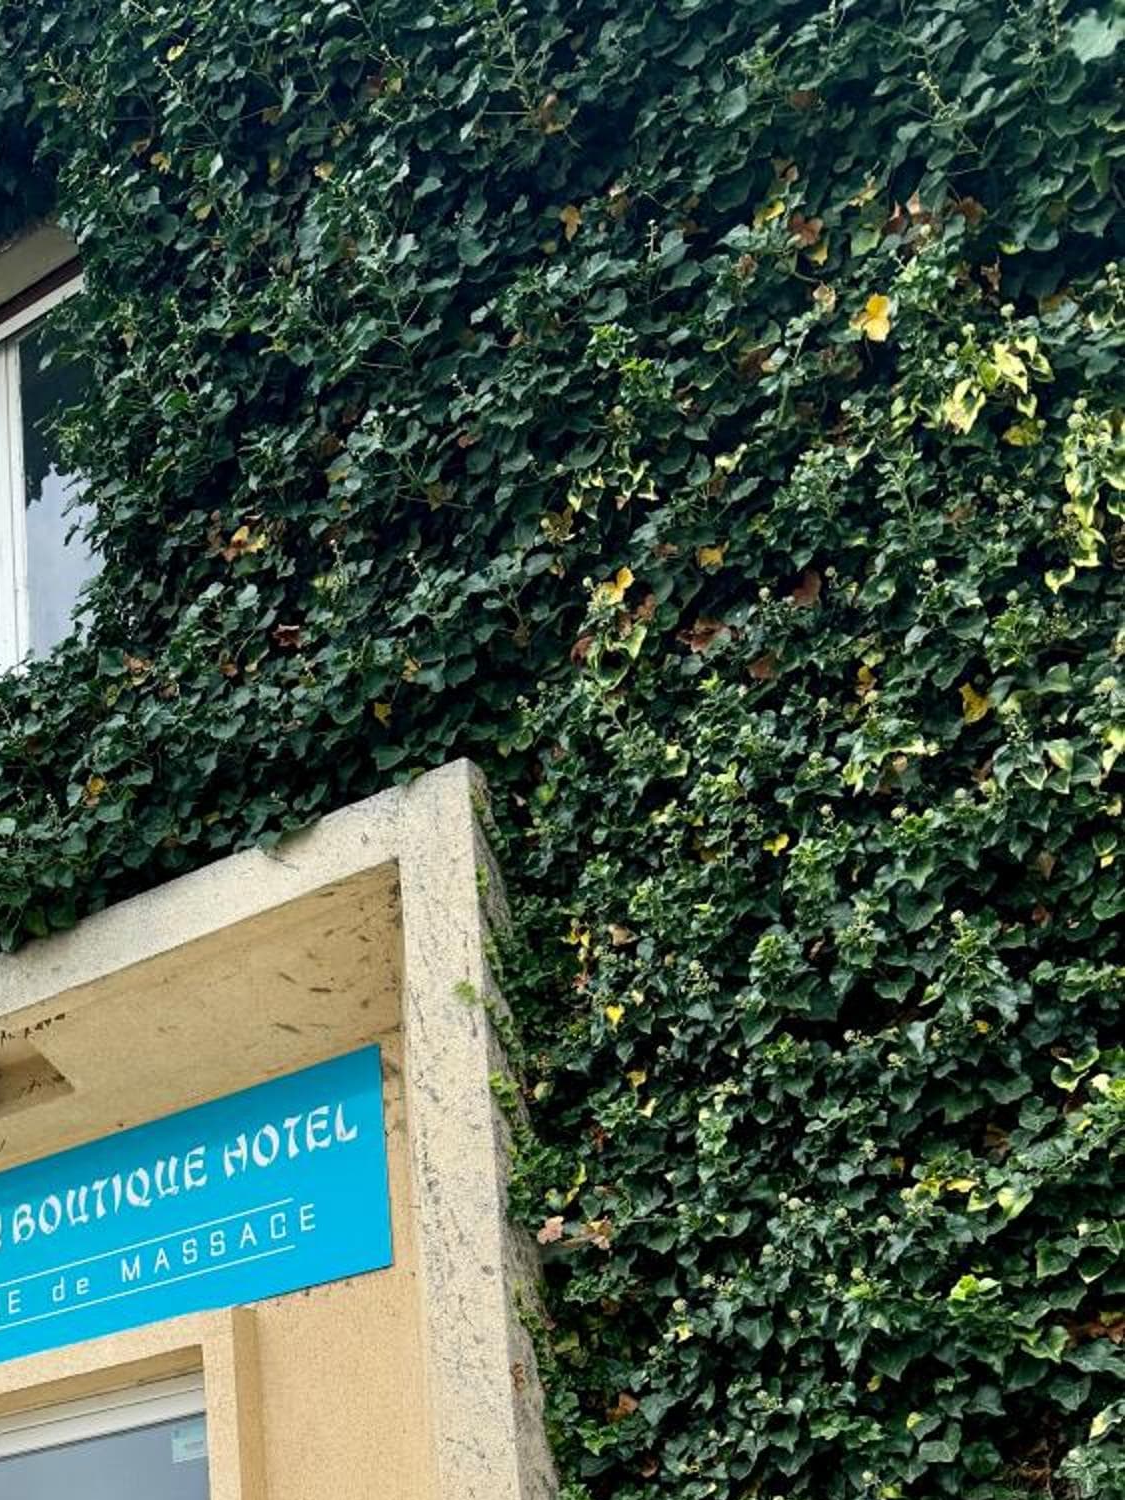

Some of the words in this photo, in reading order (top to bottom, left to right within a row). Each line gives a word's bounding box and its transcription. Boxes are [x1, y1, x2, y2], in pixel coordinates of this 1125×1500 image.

[13, 1146, 208, 1244] BOUTIQUE
[223, 1103, 358, 1178] HOTEL
[51, 1276, 91, 1302] de
[120, 1203, 316, 1283] MASSAGE
